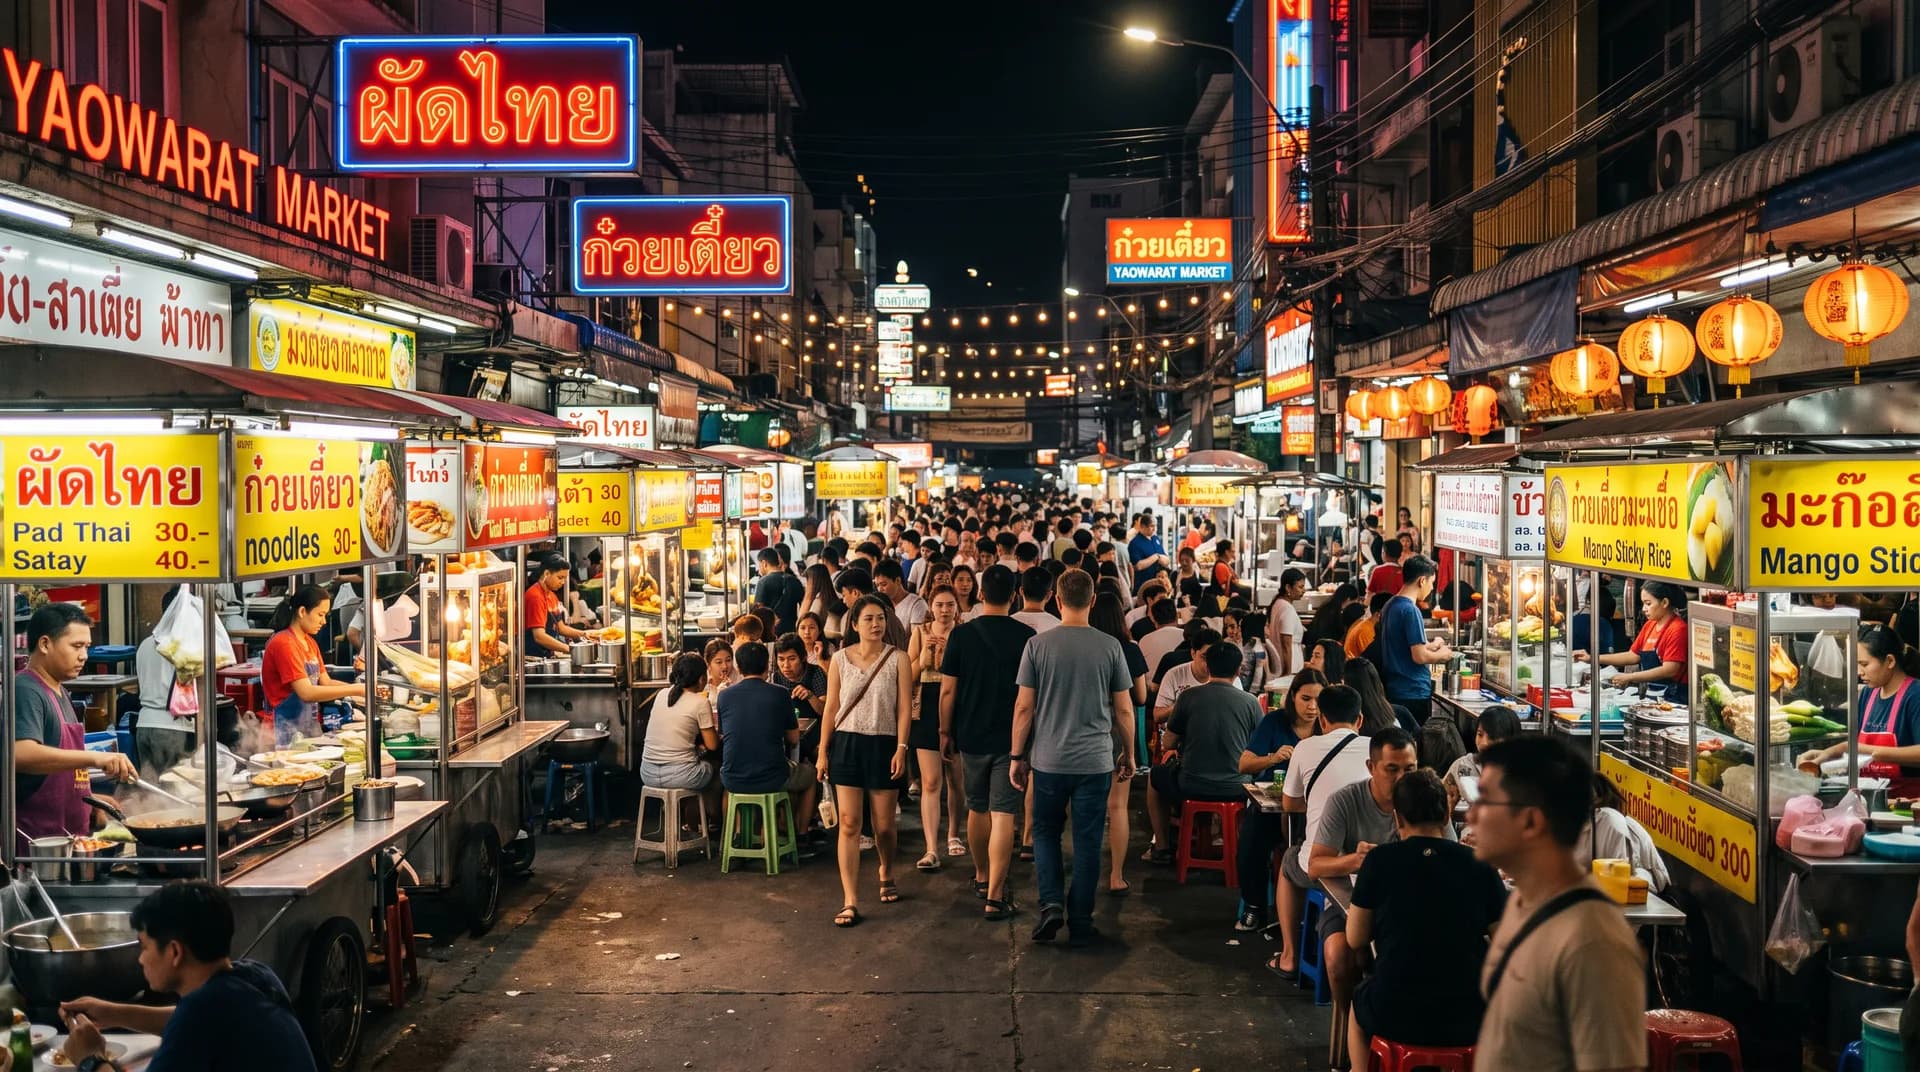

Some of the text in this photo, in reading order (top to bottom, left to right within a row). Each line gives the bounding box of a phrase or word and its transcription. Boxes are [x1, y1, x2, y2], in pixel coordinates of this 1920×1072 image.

[359, 50, 615, 144] ผัดไทย
[3, 48, 390, 262] YAOWARAT MARKET
[583, 204, 780, 276] ก๋วยเตี๋ยว
[1114, 220, 1226, 259] ก๋วยเตี๋ยว
[1114, 266, 1226, 279] YAOWARAT MARKET
[18, 442, 202, 507] ผัดไทย
[600, 484, 621, 500] 30
[13, 522, 209, 542] Pad Thai 30.-
[601, 510, 621, 527] 40
[13, 550, 210, 575] Satay 40.-
[245, 526, 320, 567] noodles
[1583, 536, 1672, 571] Mango Sticky Rice
[1760, 547, 1859, 581] Mango
[1720, 838, 1751, 883] 300
